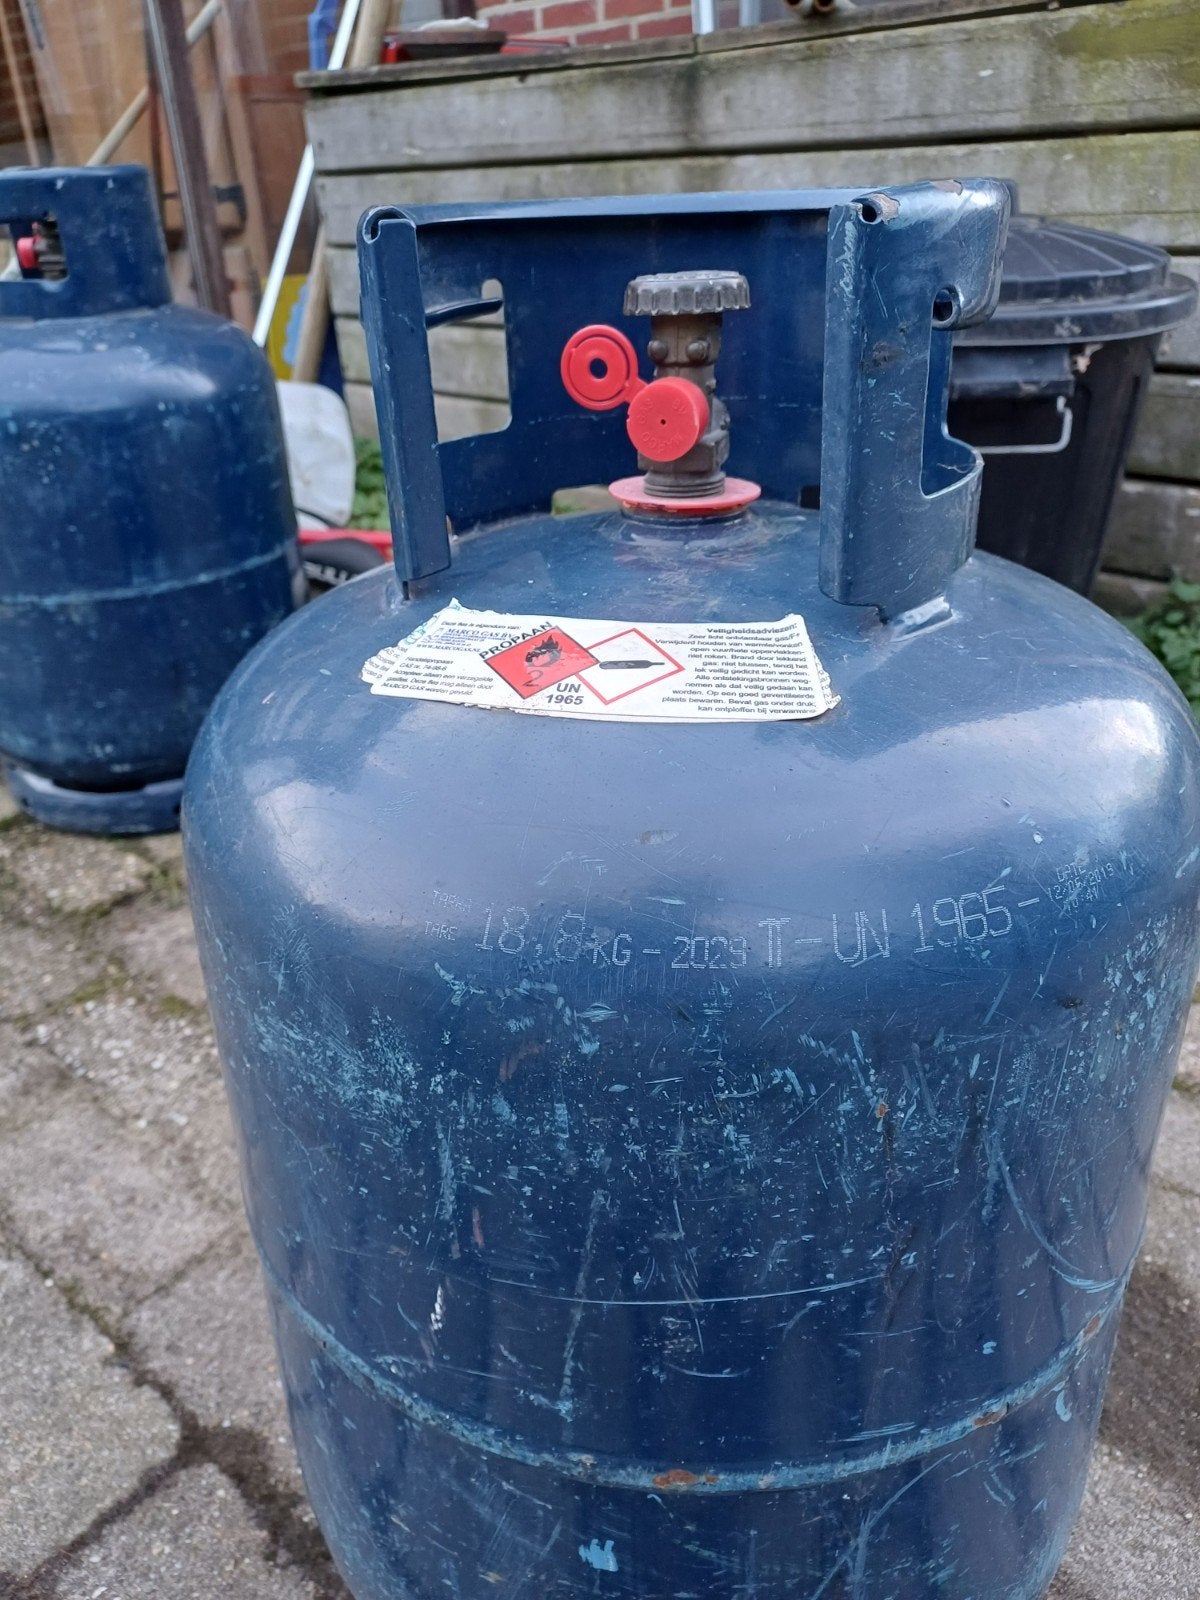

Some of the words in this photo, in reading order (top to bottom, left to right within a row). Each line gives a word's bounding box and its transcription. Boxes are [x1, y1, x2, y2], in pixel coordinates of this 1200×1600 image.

[447, 627, 480, 636] MARCO
[480, 630, 500, 638] GAS
[707, 622, 798, 634] Veiligheidsadviezen:
[479, 621, 553, 660] PROPAAN
[522, 669, 544, 687] 2
[712, 675, 790, 683] ontstekingsbronnen
[381, 682, 409, 690] MARCO
[556, 682, 581, 693] UN
[546, 694, 584, 705] 1965
[714, 705, 755, 713] ontploffen
[424, 920, 458, 941] TARE
[671, 935, 748, 969] 2029
[832, 908, 891, 964] UN
[911, 884, 1012, 954] 1965
